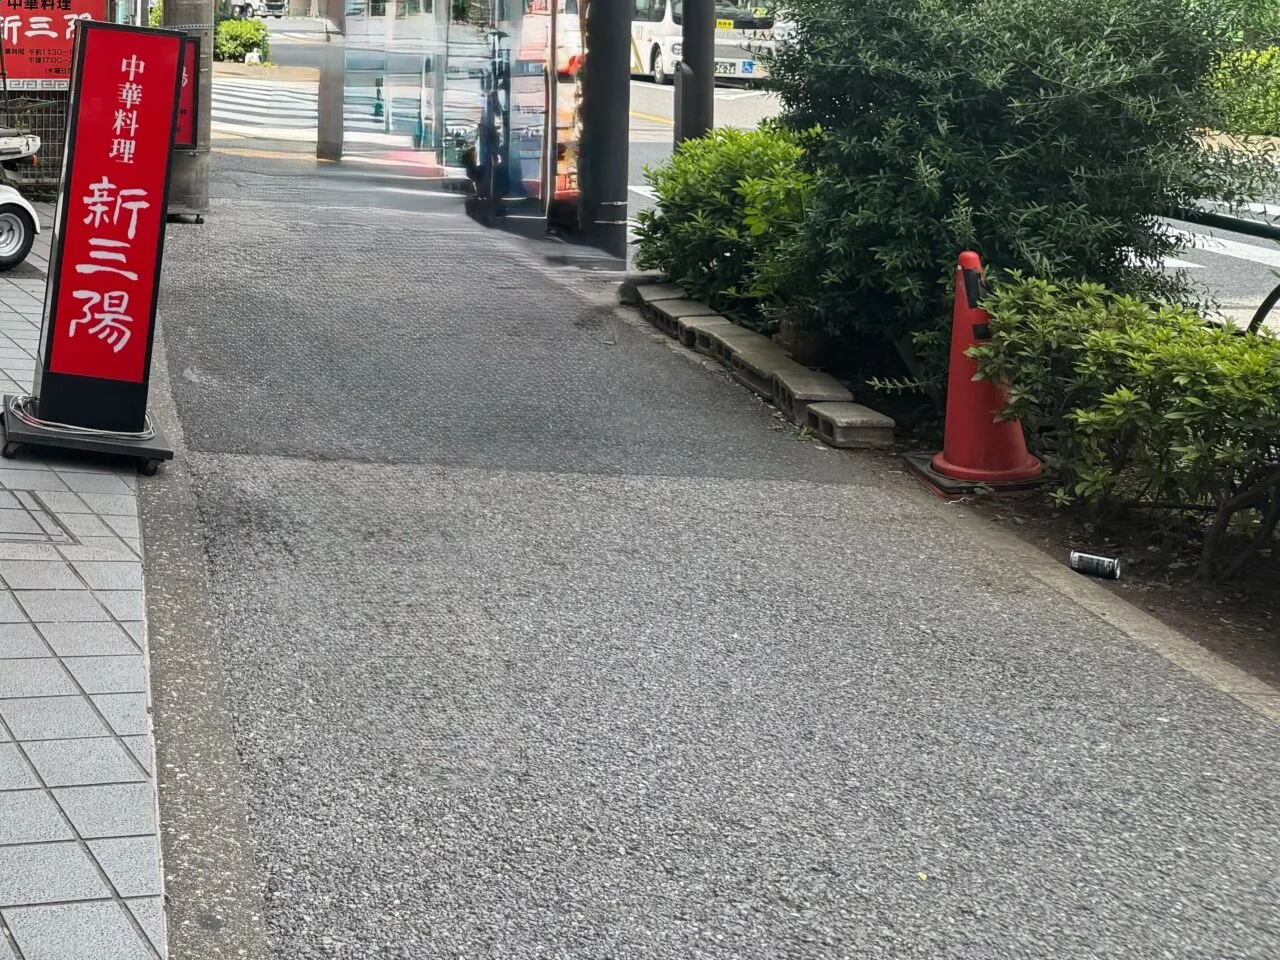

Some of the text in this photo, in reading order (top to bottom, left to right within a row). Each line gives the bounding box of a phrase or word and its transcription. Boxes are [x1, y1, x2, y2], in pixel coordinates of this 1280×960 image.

[108, 53, 146, 166] 中華料理
[69, 175, 149, 353] 新三陽
